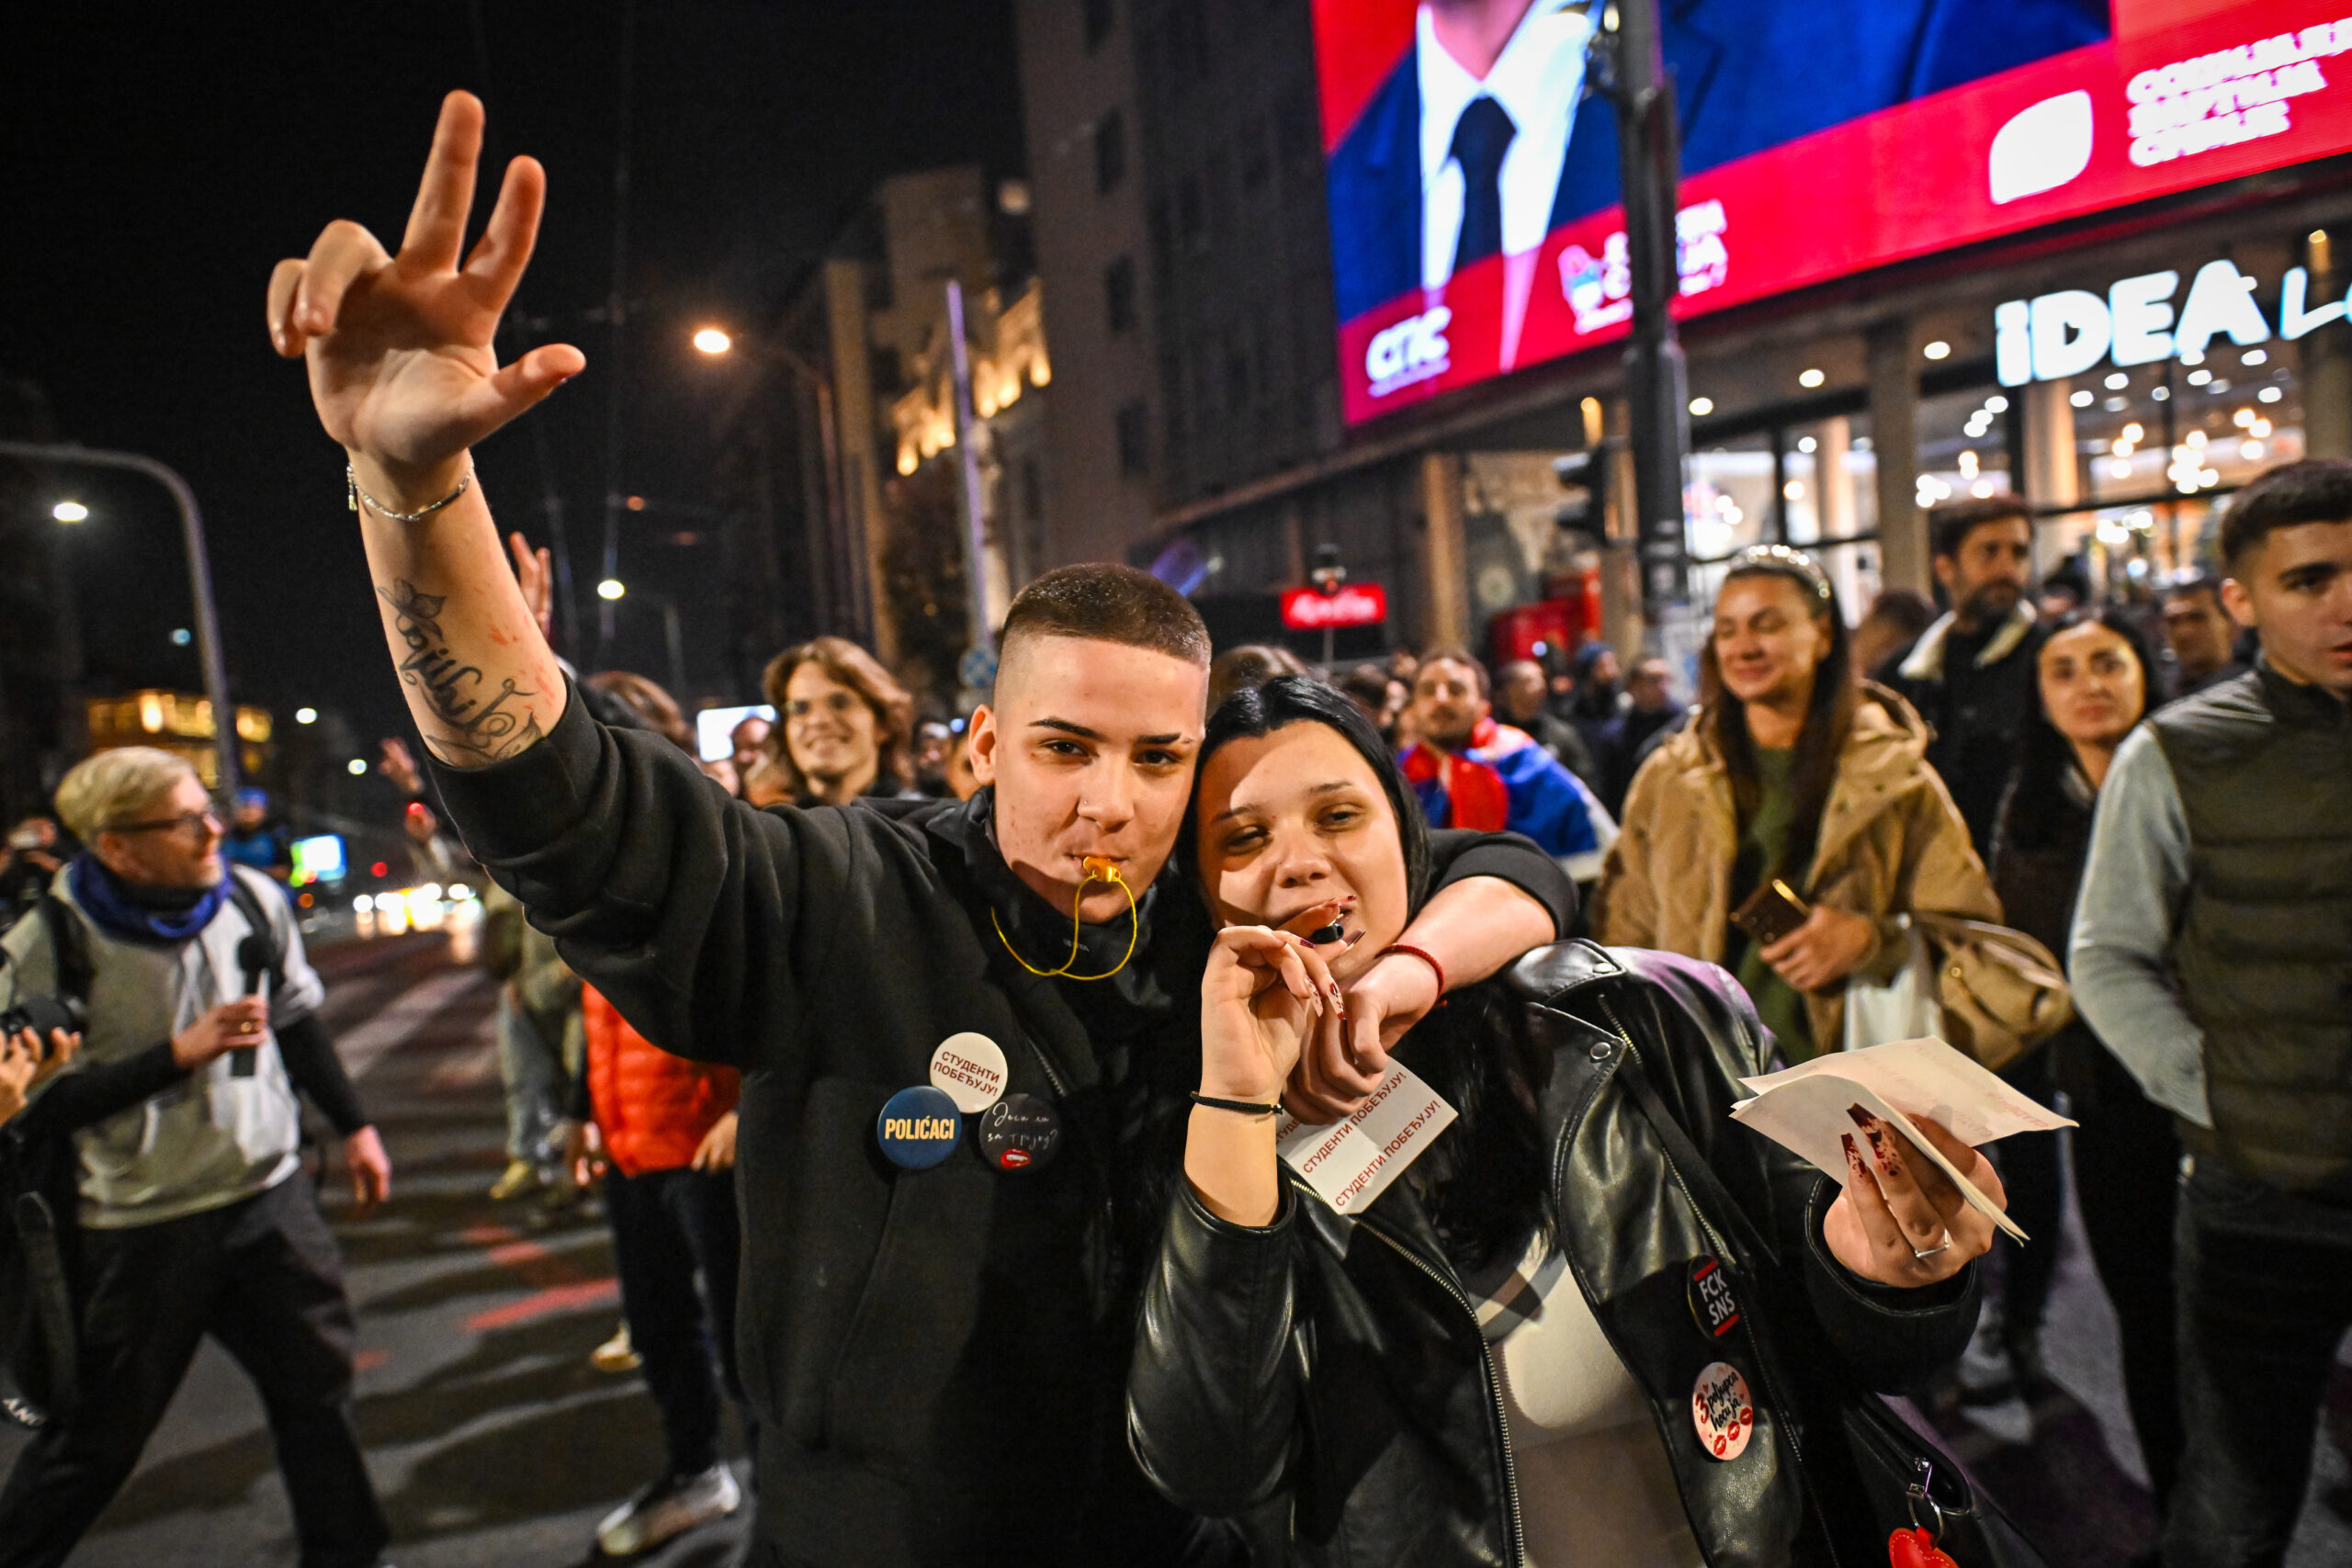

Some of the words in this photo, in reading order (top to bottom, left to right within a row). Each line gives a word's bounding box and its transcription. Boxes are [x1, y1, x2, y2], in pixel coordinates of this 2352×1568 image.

[2279, 265, 2352, 341] L
[933, 1061, 999, 1097] ПОБЕЂУЈУ!
[942, 1051, 1000, 1083] СТУДЕНТИ
[885, 1115, 955, 1140] POLIĆACI
[1303, 1123, 1352, 1174] СТУДЕНТИ
[1351, 1071, 1408, 1126] ПОБЕЂУЈУ!
[1335, 1155, 1386, 1207] СТУДЕНТИ
[1384, 1100, 1442, 1157] ПОБЕЂУЈУ!
[1699, 1268, 1728, 1303] FCK
[1708, 1291, 1736, 1325] SNS
[1695, 1393, 1709, 1424] 3
